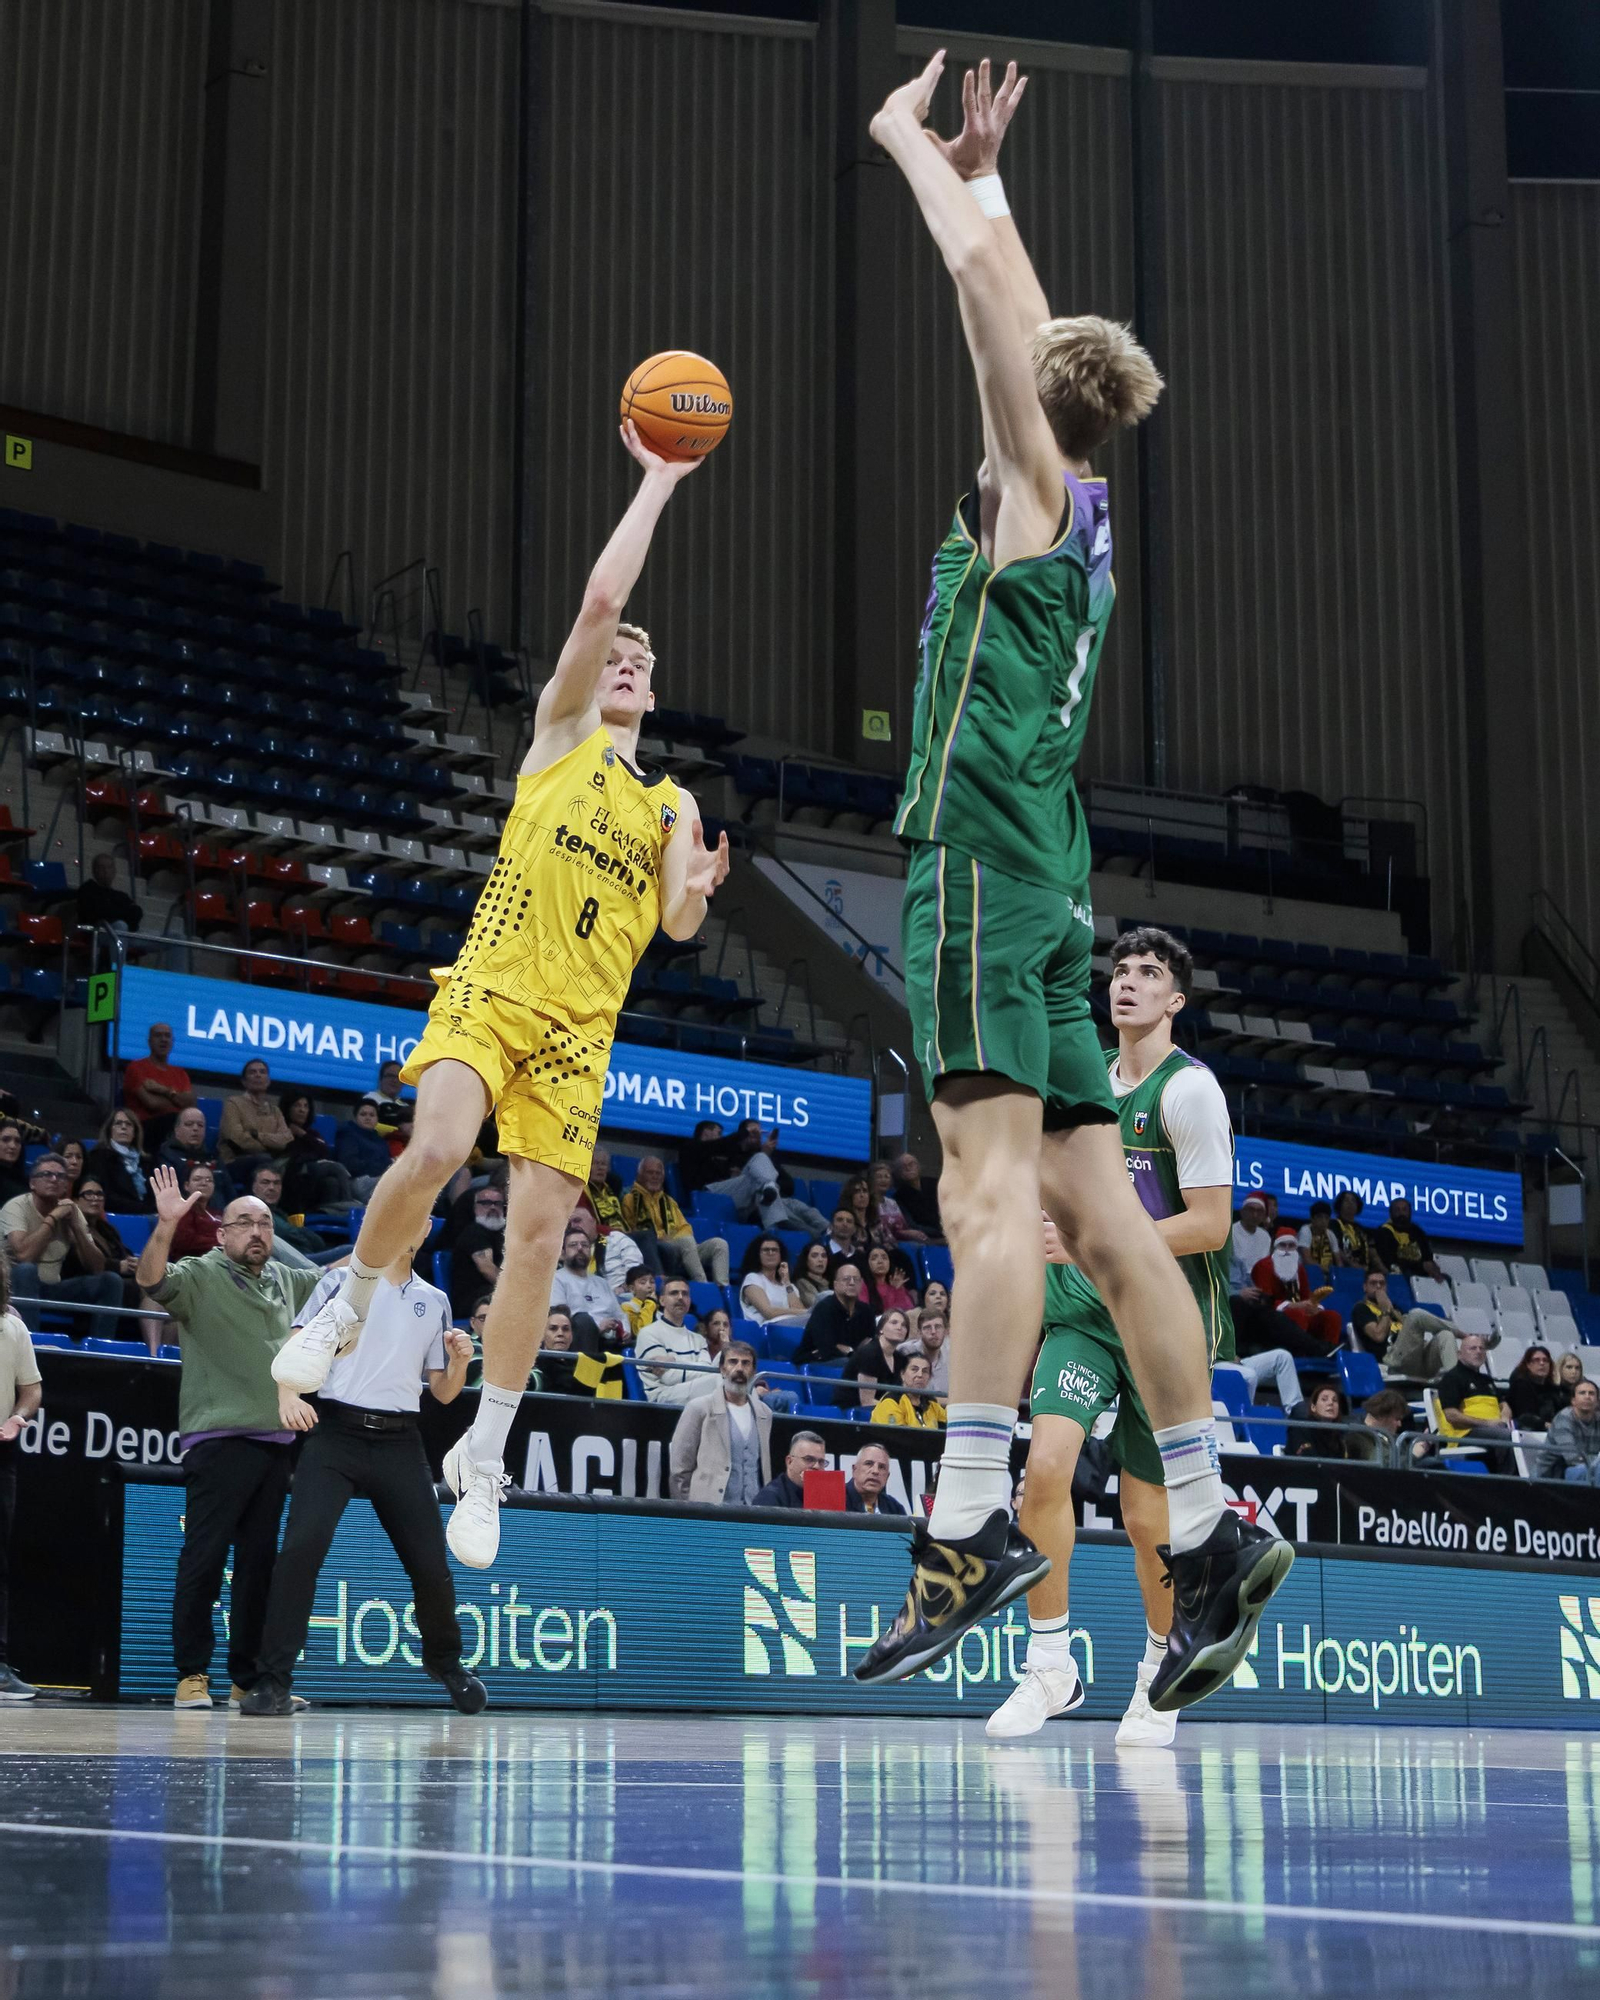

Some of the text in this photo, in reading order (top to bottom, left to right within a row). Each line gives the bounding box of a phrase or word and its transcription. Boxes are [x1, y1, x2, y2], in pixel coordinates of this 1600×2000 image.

[670, 393, 730, 415] Wilson
[13, 441, 26, 460] P
[590, 818, 608, 835] CB
[575, 896, 599, 939] 8
[94, 982, 108, 1012] P
[187, 1004, 364, 1062] LANDMAR
[695, 1082, 810, 1127] HOTELS
[1234, 1158, 1264, 1189] LS
[1414, 1185, 1508, 1222] HOTELS
[1060, 1390, 1090, 1410] DENTAL
[20, 1408, 71, 1455] de
[1358, 1505, 1469, 1550] Pabellón
[1475, 1517, 1507, 1553] de
[1276, 1622, 1483, 1711] Hospiten
